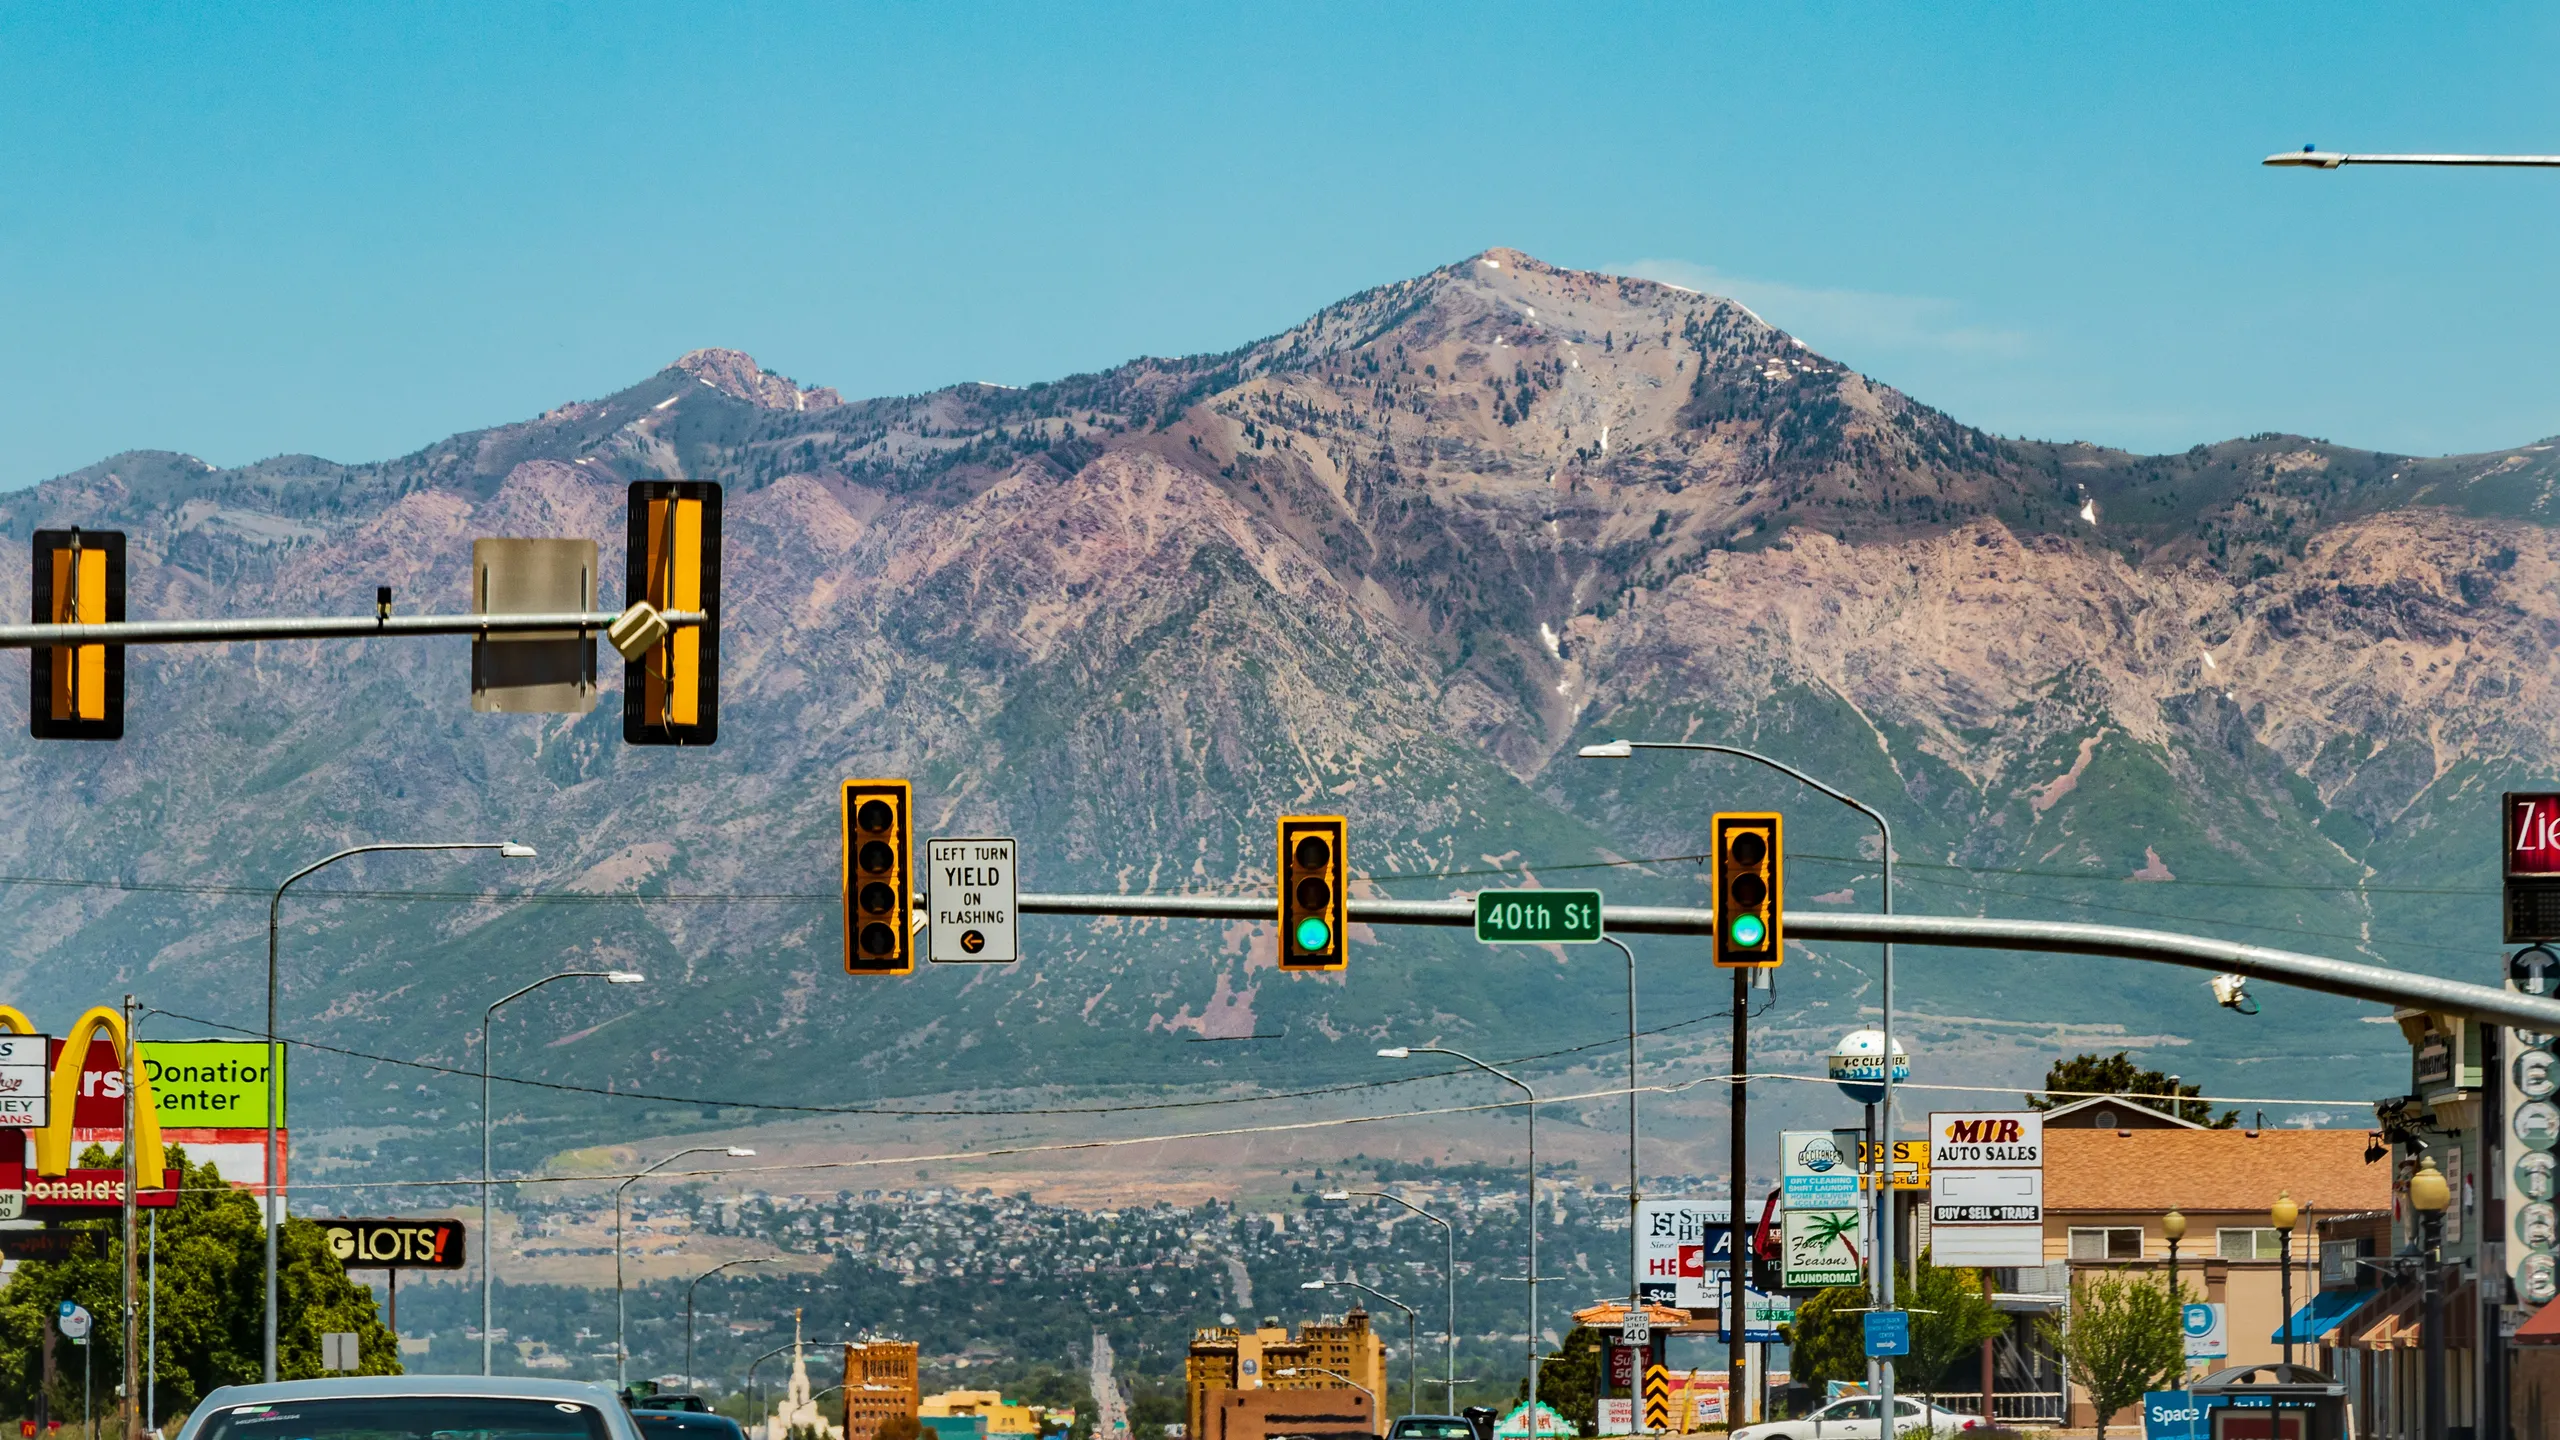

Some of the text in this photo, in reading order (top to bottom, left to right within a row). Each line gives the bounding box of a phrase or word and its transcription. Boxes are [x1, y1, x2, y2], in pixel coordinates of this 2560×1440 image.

[935, 847, 1008, 861] LEFT TURN
[945, 867, 1000, 886] YIELD
[963, 892, 981, 906] ON
[940, 911, 1004, 924] FLASHING
[1487, 903, 1592, 930] 40th St
[1862, 1057, 1906, 1067] CLEAERS
[1950, 1120, 2019, 1143] MIR
[1937, 1147, 1980, 1160] AUTO
[1986, 1147, 2037, 1160] SALES
[1938, 1207, 2035, 1219] BUY SELL TRADE
[1650, 1240, 1674, 1249] Since
[1792, 1236, 1823, 1251] Four
[1793, 1253, 1848, 1266] Seasons
[1788, 1272, 1858, 1284] LAUNDROMAT
[1625, 1329, 1647, 1341] 40
[1614, 1354, 1650, 1366] Sui
[2152, 1406, 2199, 1426] Space
